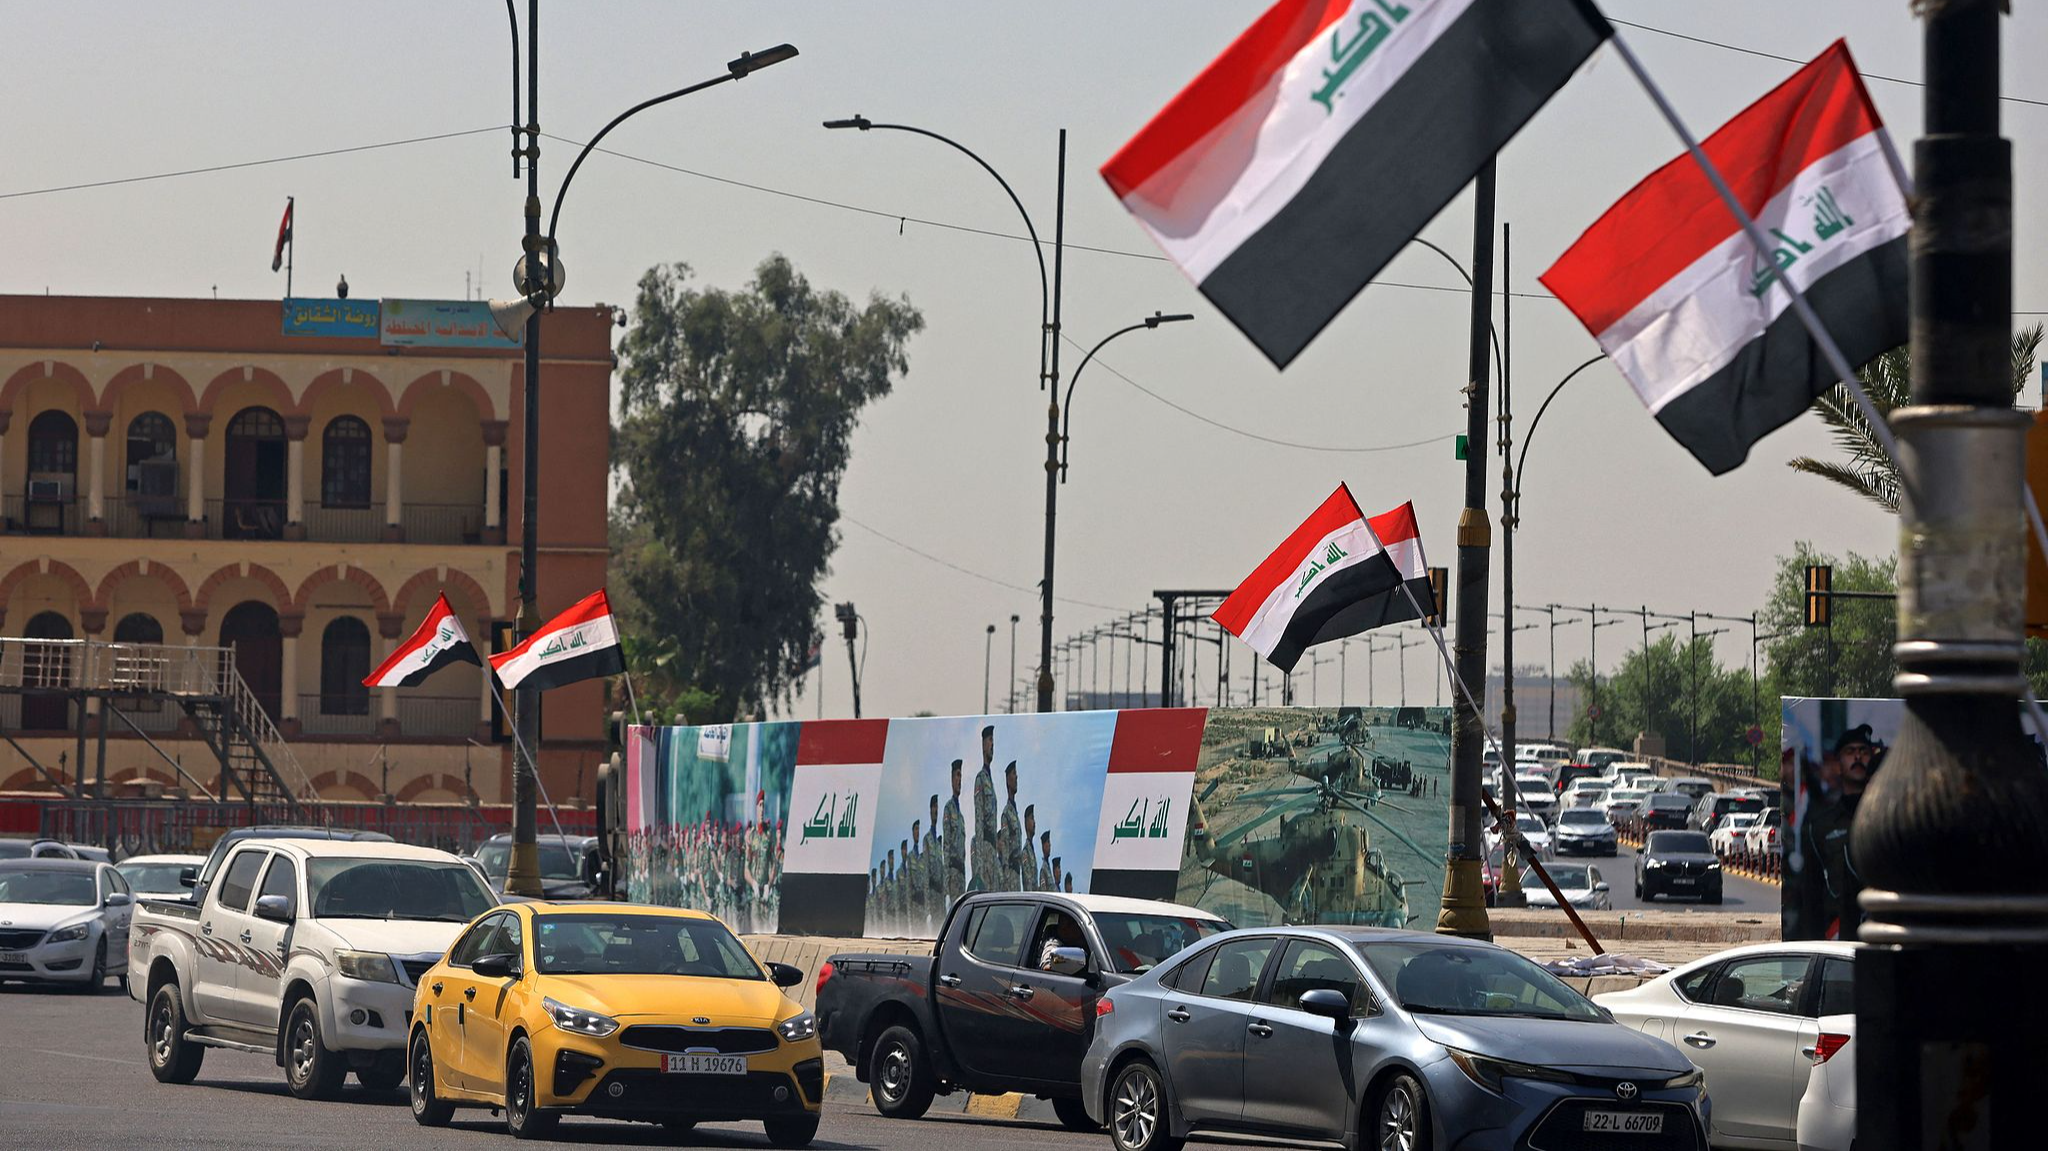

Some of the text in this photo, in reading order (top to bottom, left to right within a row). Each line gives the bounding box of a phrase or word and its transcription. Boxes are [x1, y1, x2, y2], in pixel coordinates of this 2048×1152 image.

[345, 305, 377, 329] روضة
[1324, 541, 1348, 565] الله
[570, 630, 587, 648] الله
[837, 788, 858, 838] الله
[1148, 794, 1171, 838] الله
[670, 1056, 687, 1071] 11
[691, 1057, 699, 1071] H
[704, 1058, 743, 1072] 19676
[1625, 1115, 1660, 1131] 66709
